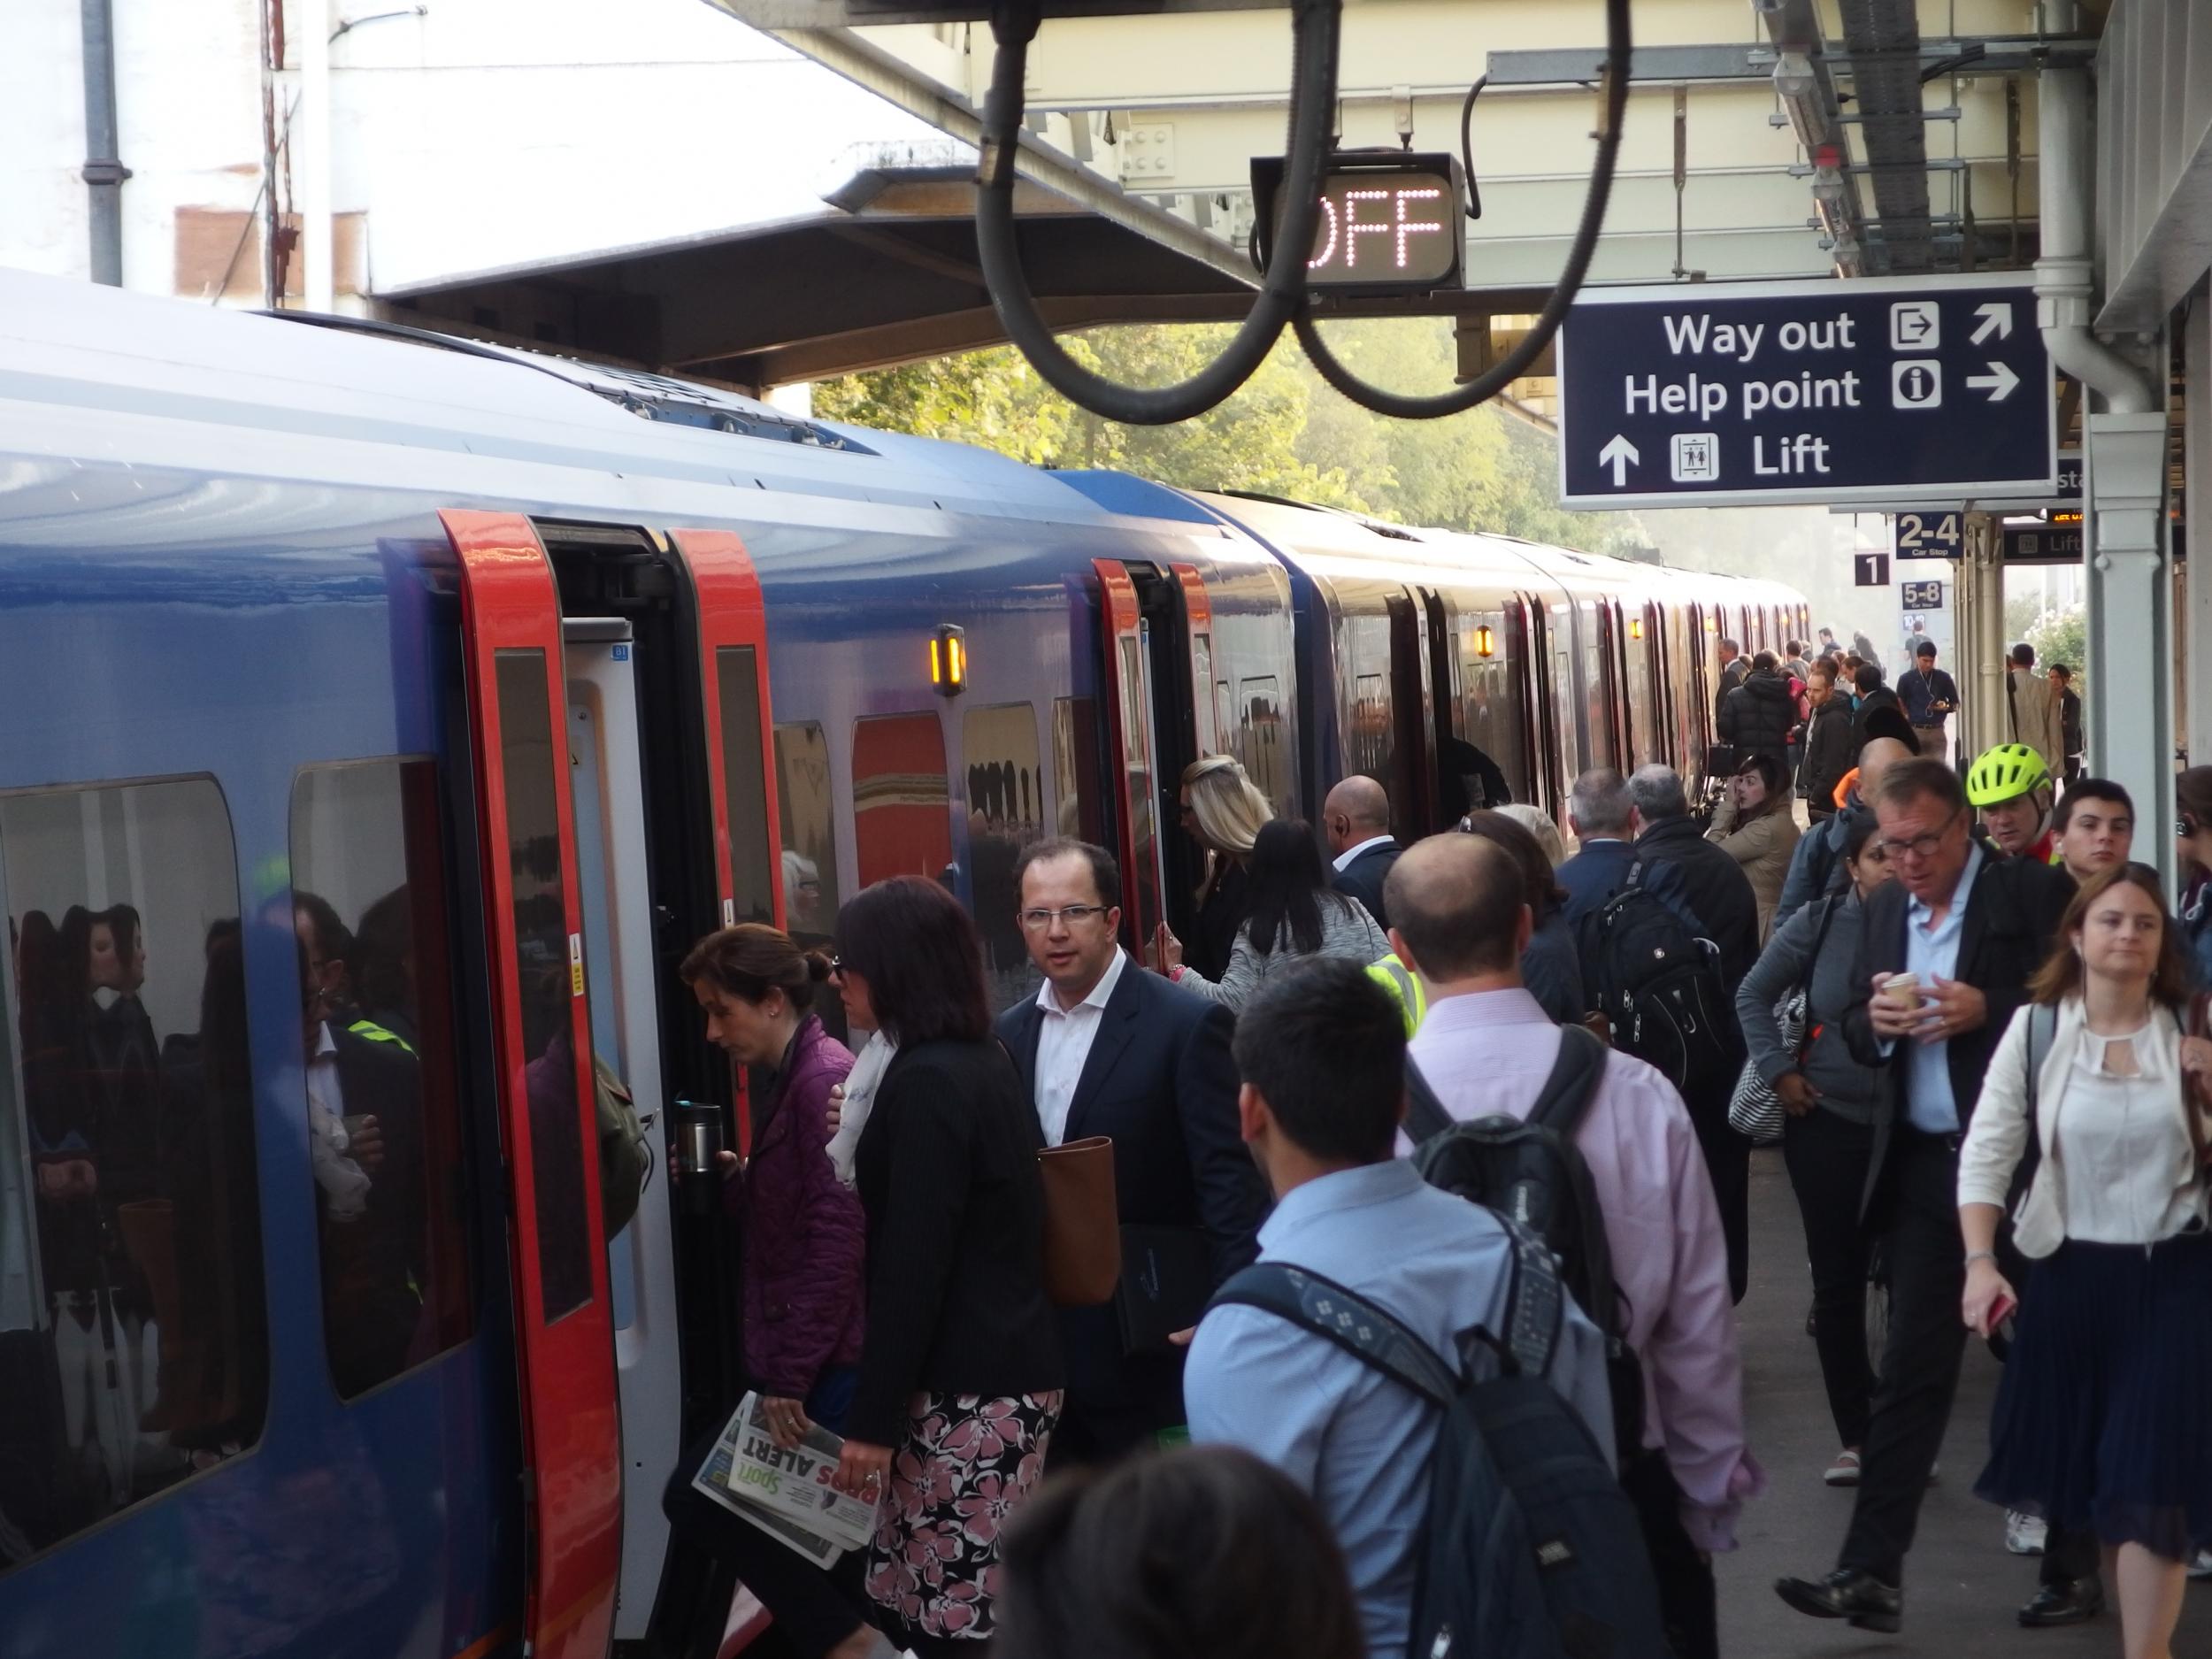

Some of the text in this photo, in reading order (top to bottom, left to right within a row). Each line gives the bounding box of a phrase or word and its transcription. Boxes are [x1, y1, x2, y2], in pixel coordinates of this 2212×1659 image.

[1663, 311, 1856, 363] Way out
[1624, 370, 1861, 422] Help point
[1753, 434, 1831, 475] Lift
[1899, 514, 1960, 547] 2-4
[2050, 535, 2082, 551] Lift
[1865, 557, 1878, 583] 1
[1904, 582, 1940, 603] 5-8
[742, 1436, 816, 1478] ALERT
[737, 1462, 781, 1495] Sport
